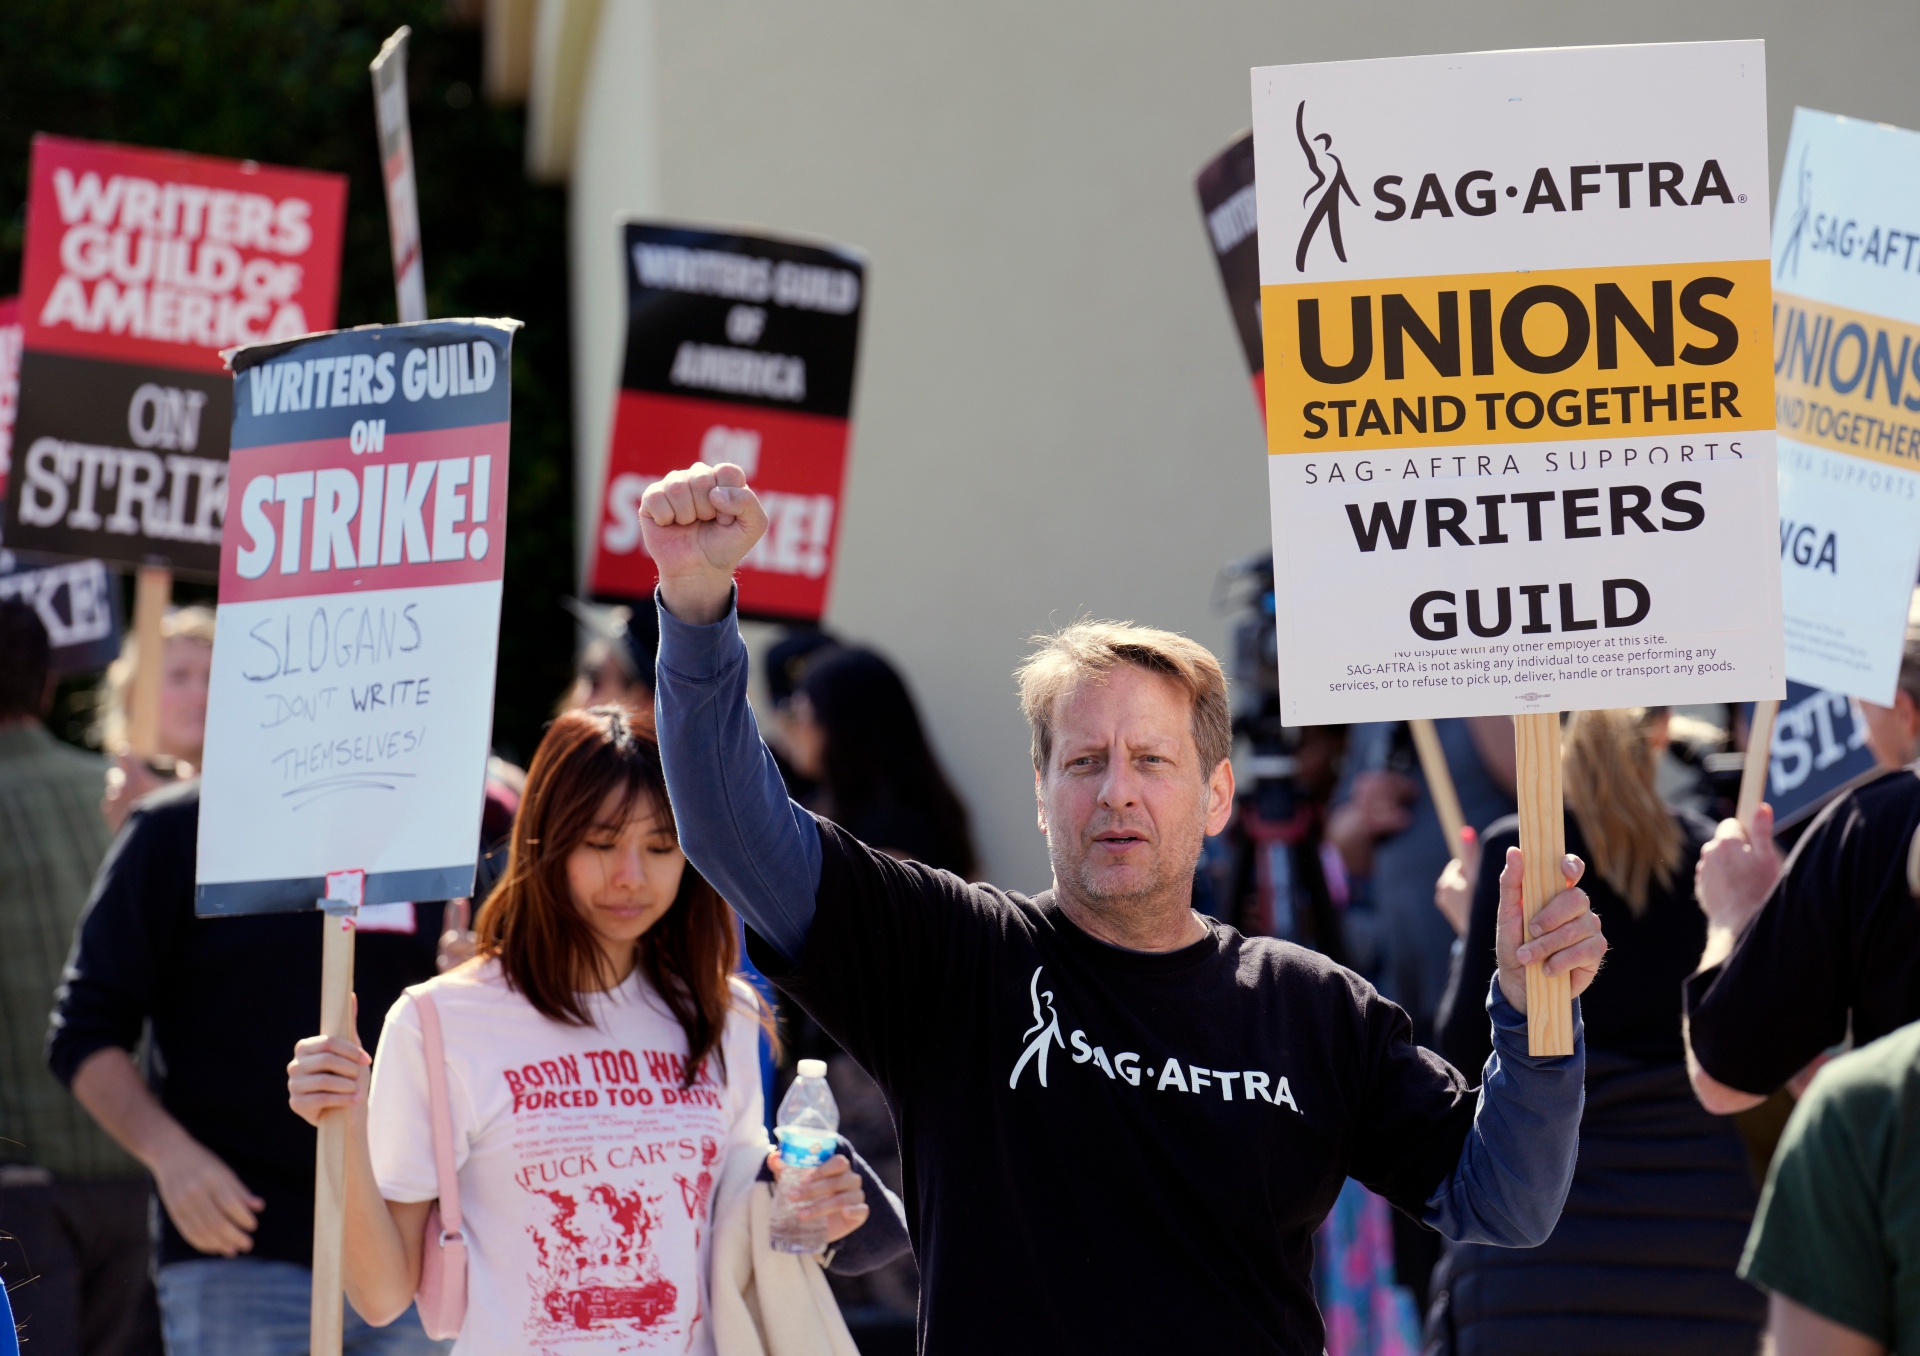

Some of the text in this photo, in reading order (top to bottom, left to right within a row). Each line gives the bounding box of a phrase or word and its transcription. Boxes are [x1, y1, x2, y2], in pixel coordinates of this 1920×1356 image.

[52, 167, 313, 256] WRITERS
[60, 223, 304, 303] GUILD OF
[630, 241, 860, 316] WRITERS GUILD
[39, 273, 310, 348] AMERICA
[724, 302, 769, 346] OF
[1298, 276, 1739, 385] UNIONS
[250, 340, 496, 417] WRITERS GUILD
[669, 341, 807, 403] AMERICA
[128, 382, 207, 452] ON
[350, 418, 386, 456] ON
[1302, 380, 1742, 439] STAND TOGETHER
[1809, 400, 1920, 461] TOGETHER
[18, 436, 229, 546] STRIK
[1305, 454, 1520, 485] SAG-AFTRA
[1545, 442, 1743, 472] SUPPORTS
[235, 454, 492, 580] STRIKE!
[1345, 480, 1706, 553] WRITERS
[1409, 578, 1652, 641] GUILD
[241, 602, 424, 683] SLOGANS
[1347, 647, 1717, 676] SAG-AFTRA is not asking any individual to cease performing any
[1489, 645, 1510, 657] any
[1547, 638, 1601, 653] employer
[1604, 637, 1616, 647] at
[1619, 635, 1641, 646] this
[1644, 634, 1668, 645] site.
[350, 676, 431, 713] WRITE
[1329, 660, 1736, 692] services, or to refuse to pick up, deliver, handle or transport any goods.
[271, 725, 428, 780] THEMSELVES!
[503, 1048, 716, 1096] BORN TOO WAK
[512, 1087, 599, 1114] FORCED
[602, 1087, 654, 1107] TOO
[521, 1151, 600, 1187] FUCK
